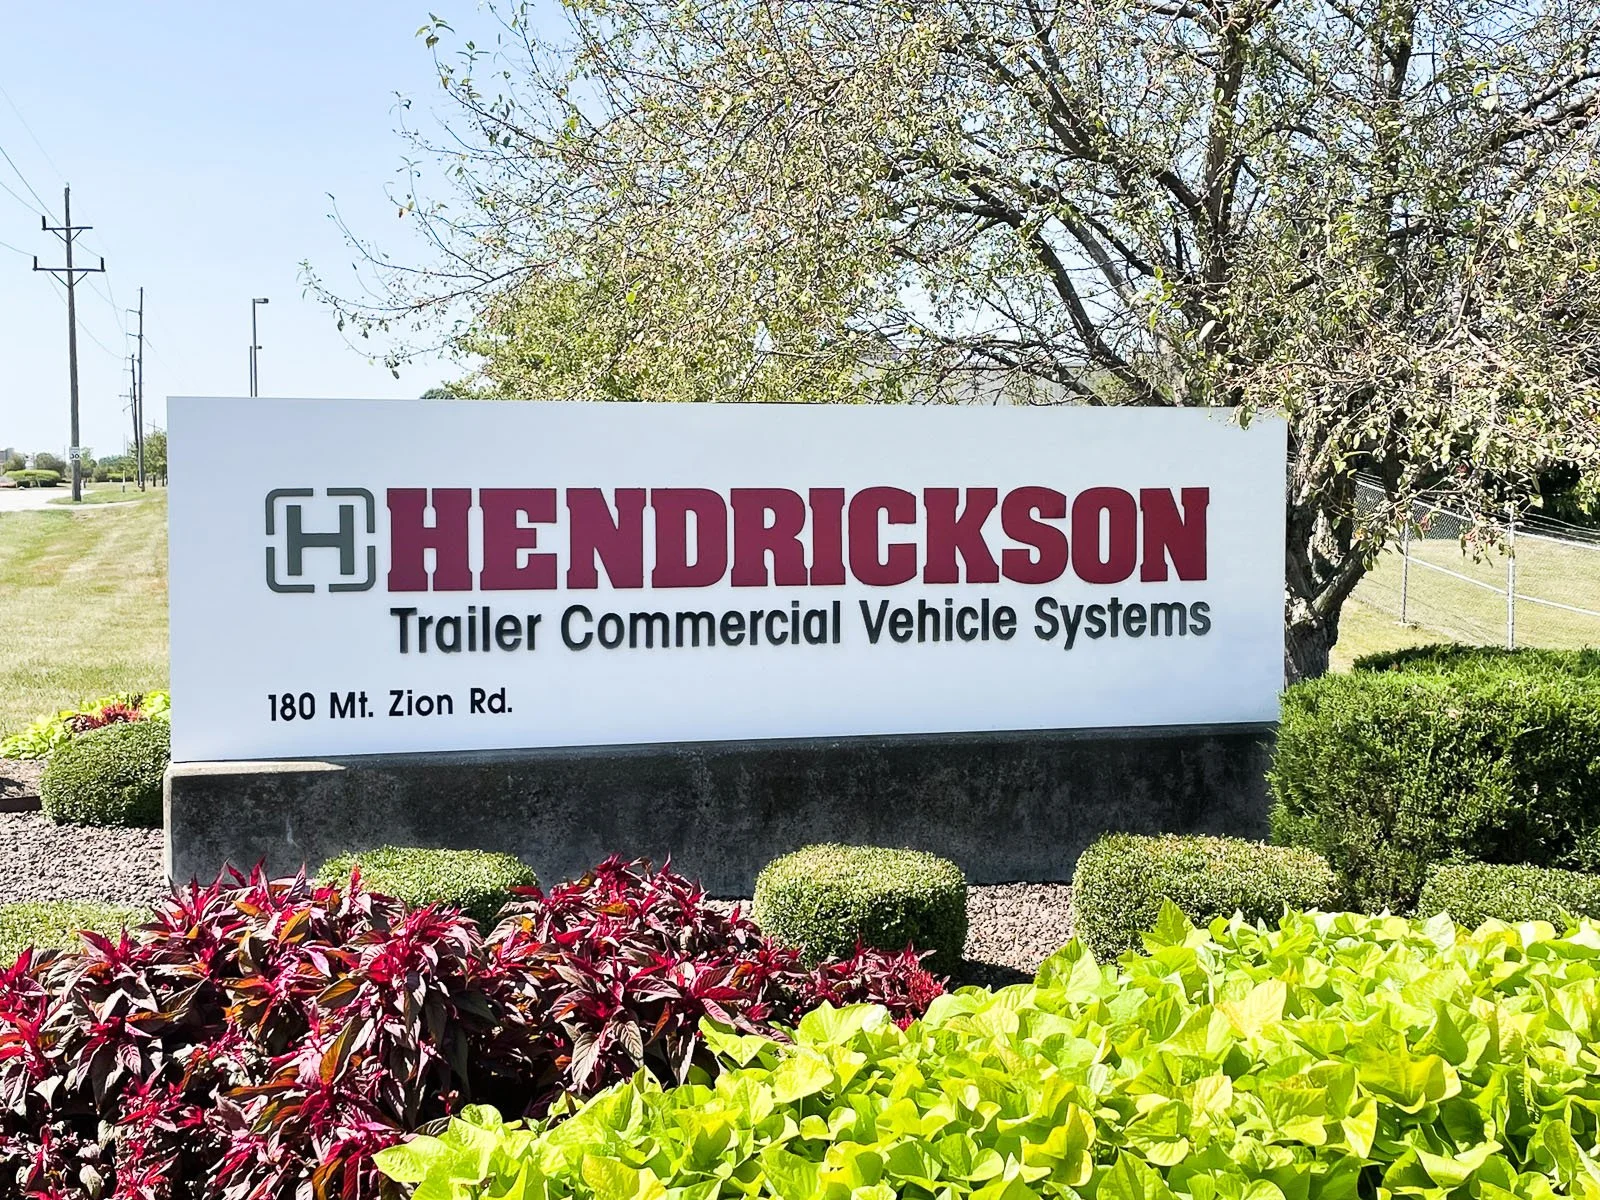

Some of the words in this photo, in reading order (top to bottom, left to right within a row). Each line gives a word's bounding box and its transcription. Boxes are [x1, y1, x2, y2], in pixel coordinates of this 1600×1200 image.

[386, 486, 1210, 593] HENDRICKSON
[389, 605, 542, 655] Trailer
[560, 600, 841, 652] Commercial
[858, 597, 1018, 645] Vehicle
[1034, 596, 1212, 651] Systems
[267, 691, 317, 722] 180
[329, 691, 374, 719] Mt.
[388, 689, 454, 717] Zion
[470, 687, 513, 714] Rd.
